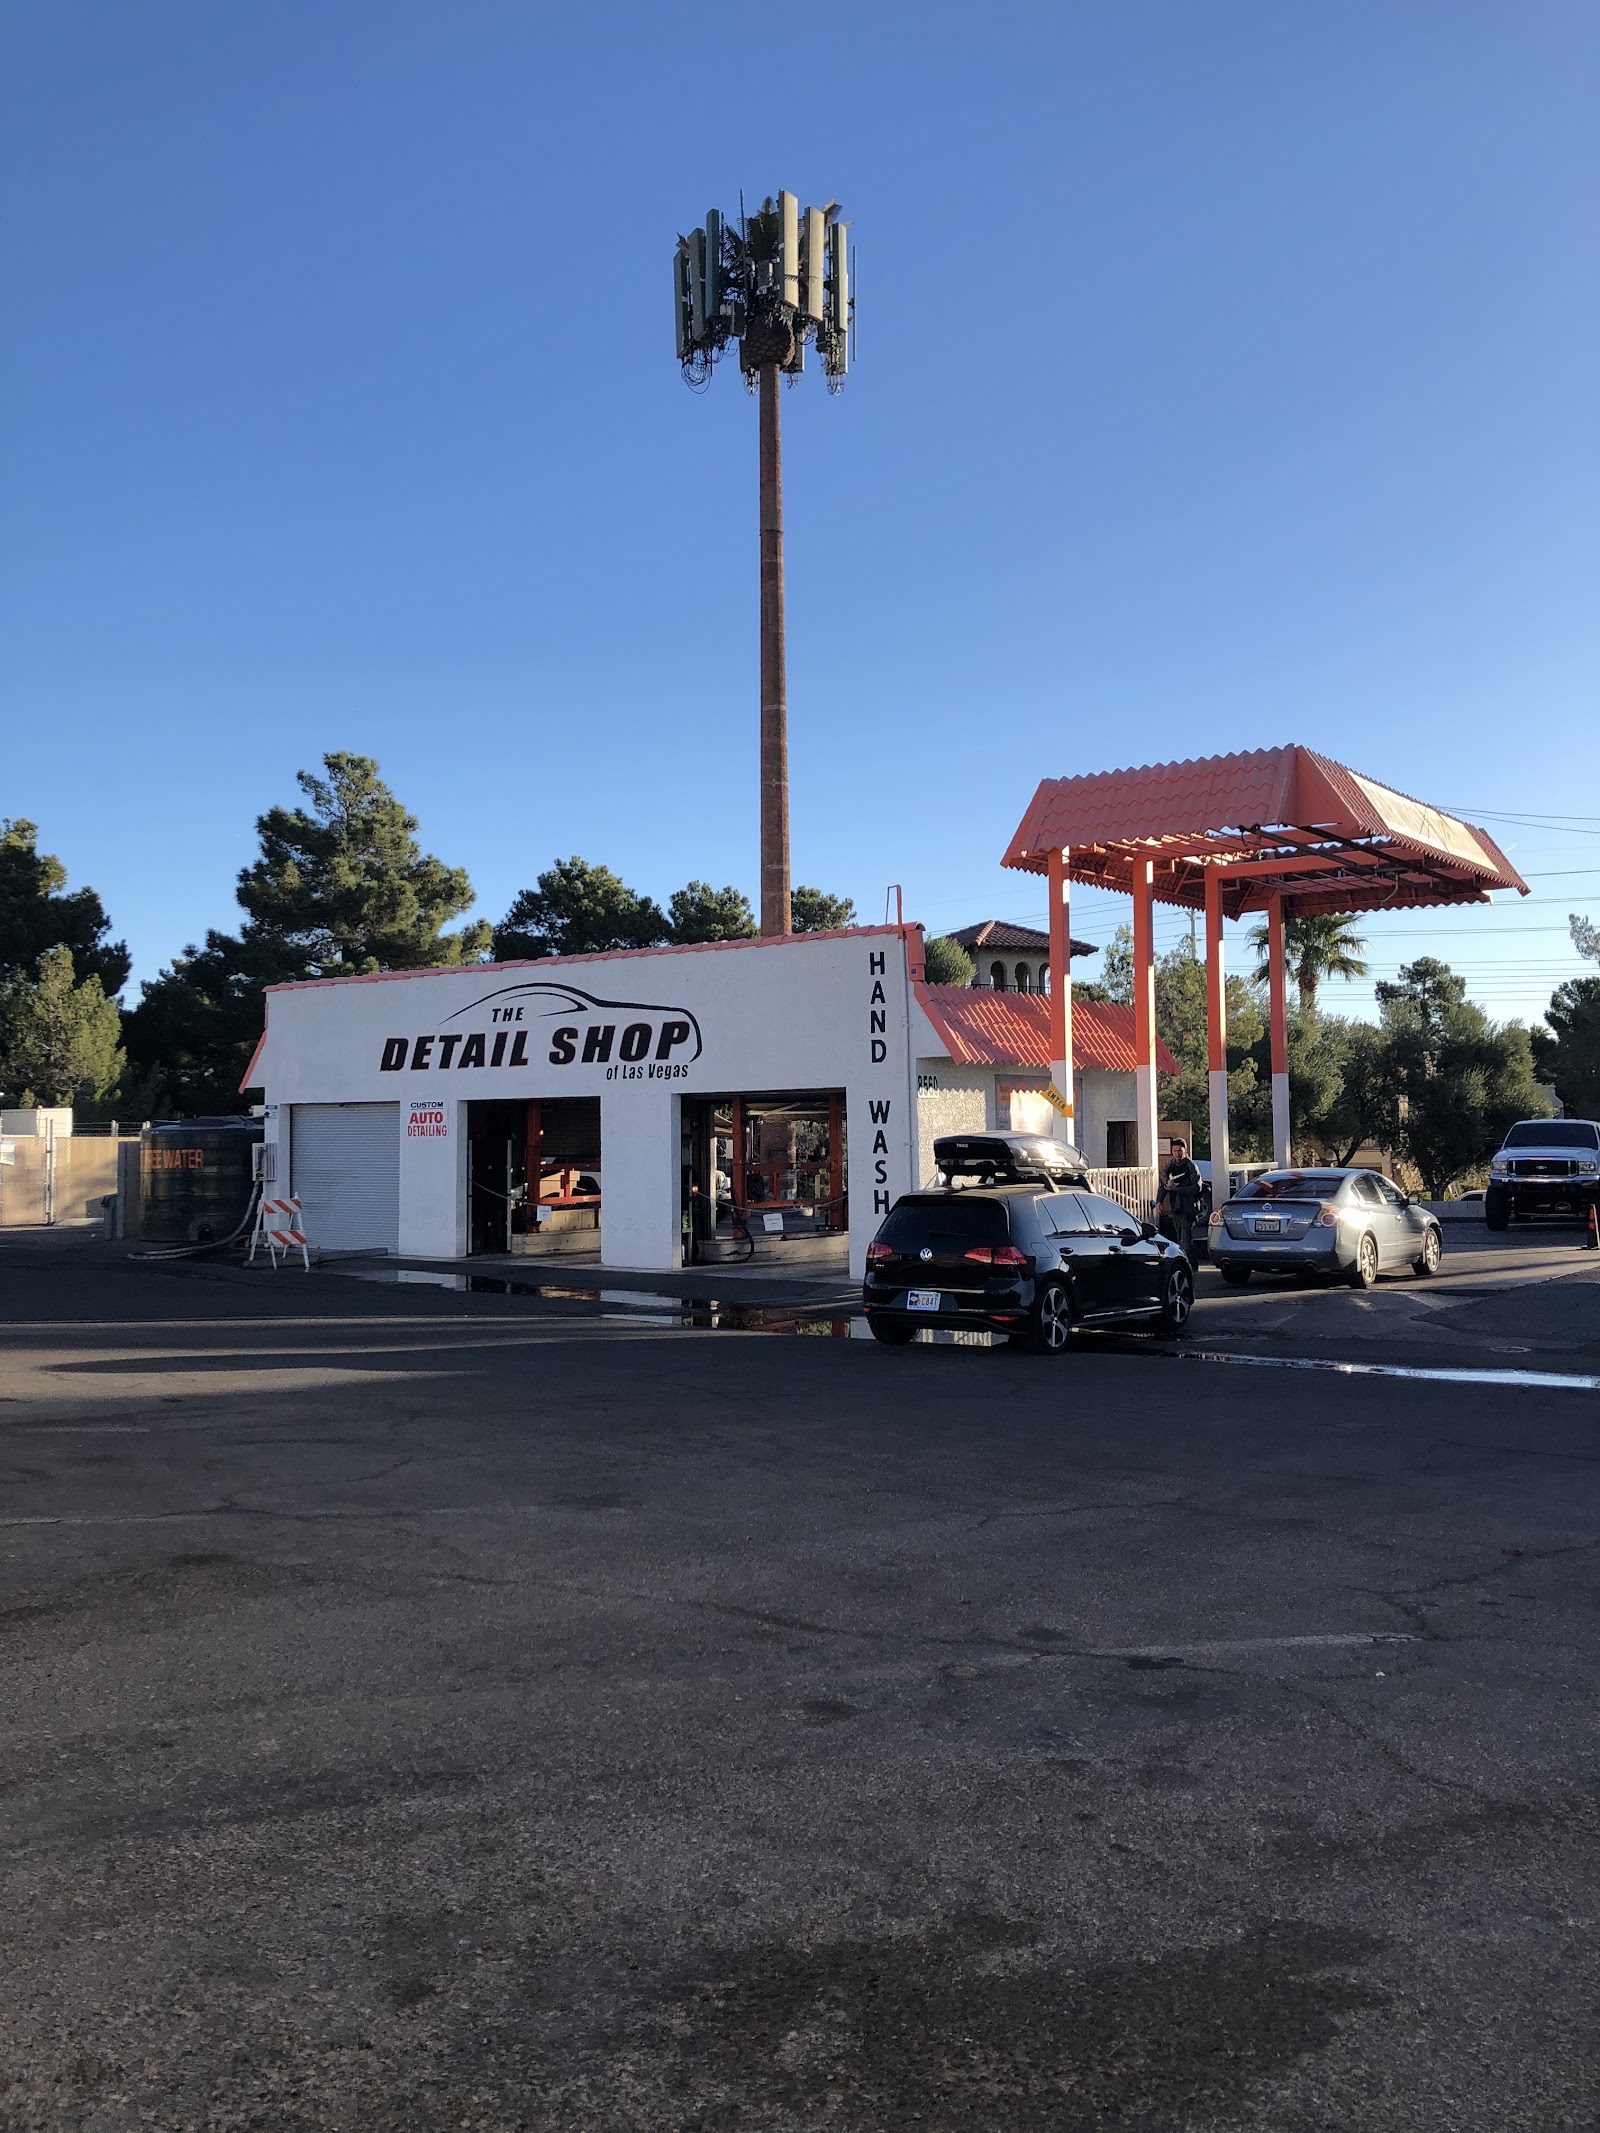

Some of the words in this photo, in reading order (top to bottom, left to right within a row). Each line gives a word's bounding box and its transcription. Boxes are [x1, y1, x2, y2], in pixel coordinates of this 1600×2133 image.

[492, 1007, 524, 1022] THE
[869, 951, 887, 1063] HAND
[380, 1030, 529, 1071] DETAIL
[548, 1021, 690, 1065] SHOP
[606, 1065, 618, 1080] of
[622, 1064, 643, 1079] Las
[648, 1063, 688, 1080] Vegas
[1047, 1090, 1066, 1110] ENTER
[409, 1111, 443, 1124] AUTO
[407, 1124, 447, 1136] DETAILING
[162, 1148, 204, 1168] WATER
[868, 1100, 891, 1214] WASH
